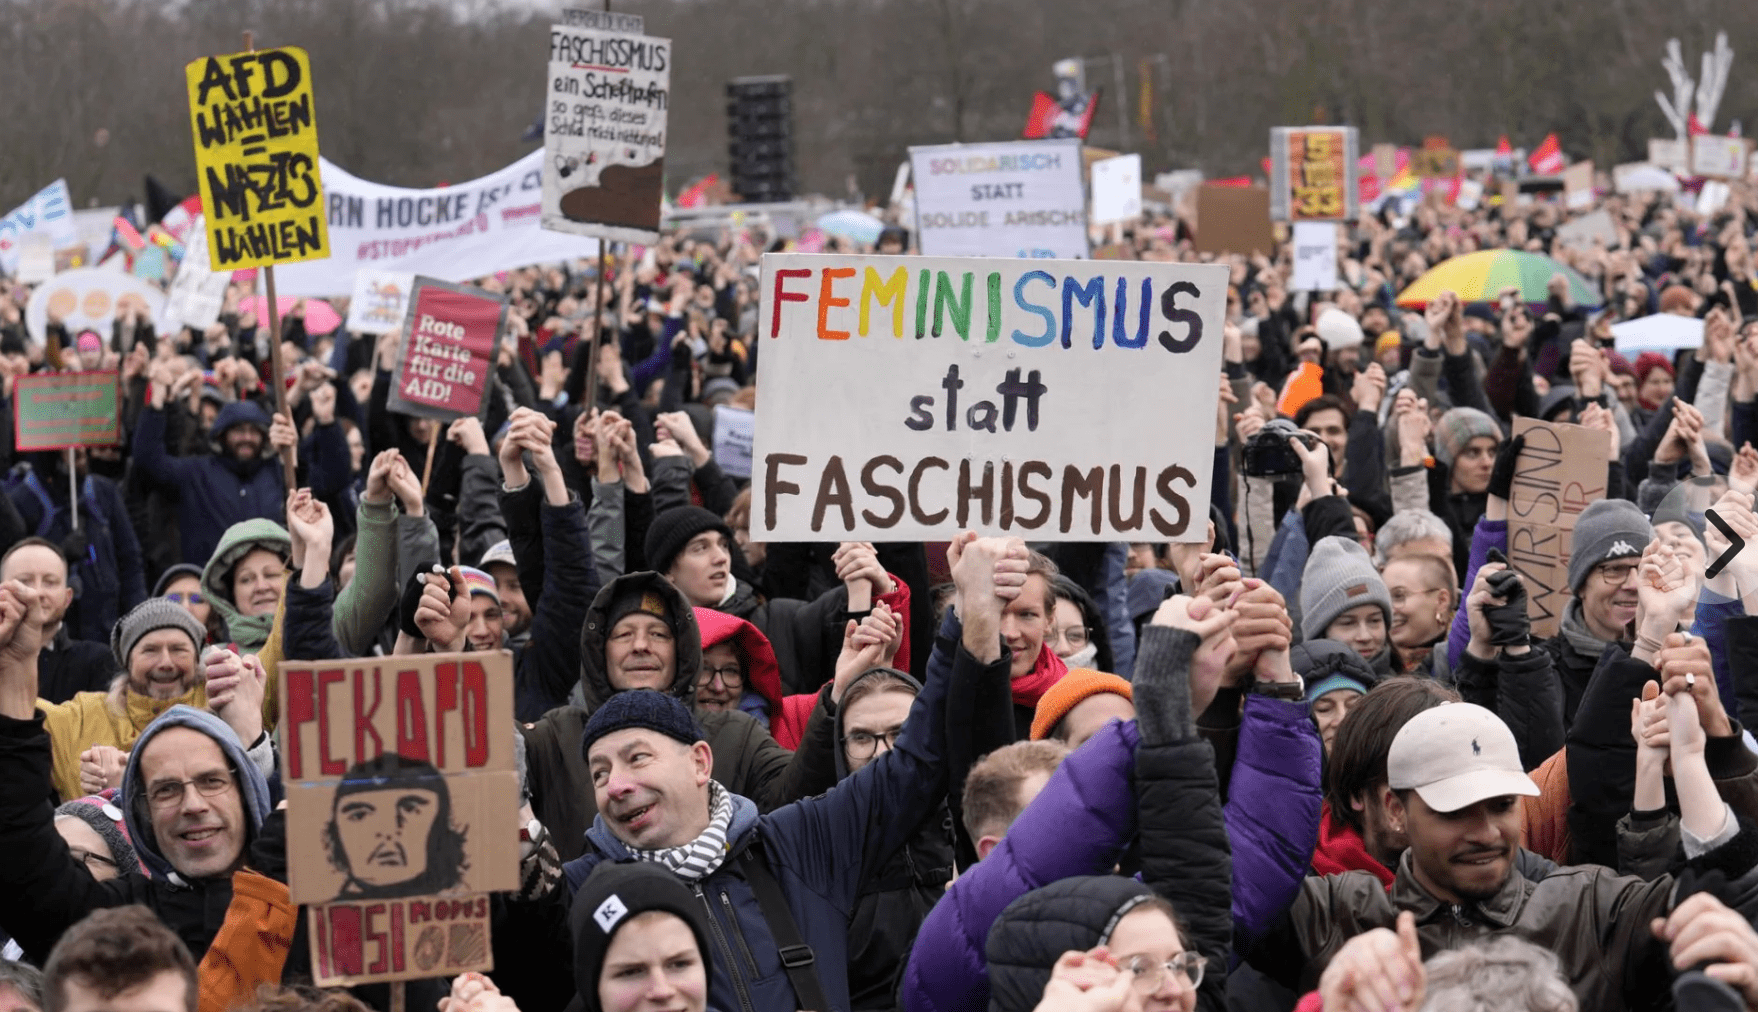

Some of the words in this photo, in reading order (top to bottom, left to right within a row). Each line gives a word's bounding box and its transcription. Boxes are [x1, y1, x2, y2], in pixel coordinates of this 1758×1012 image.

[551, 31, 666, 72] FASCHISSMUS
[197, 50, 302, 106] AFD
[554, 76, 578, 96] ein
[929, 153, 1061, 176] SOLIDARISCH
[205, 151, 318, 222] NAZIS
[970, 182, 1025, 201] STATT
[921, 210, 989, 228] SOLIDE
[770, 265, 1204, 354] FEMINISMUS
[419, 313, 466, 341] Rote
[415, 335, 471, 363] Karte
[409, 354, 442, 379] für
[443, 363, 476, 386] die
[404, 377, 453, 403] AfD!
[904, 363, 1048, 434] statt
[1511, 425, 1563, 524] SIND
[764, 453, 1197, 536] FASCHISMUS
[1511, 527, 1558, 622] WIR
[601, 903, 618, 921] K
